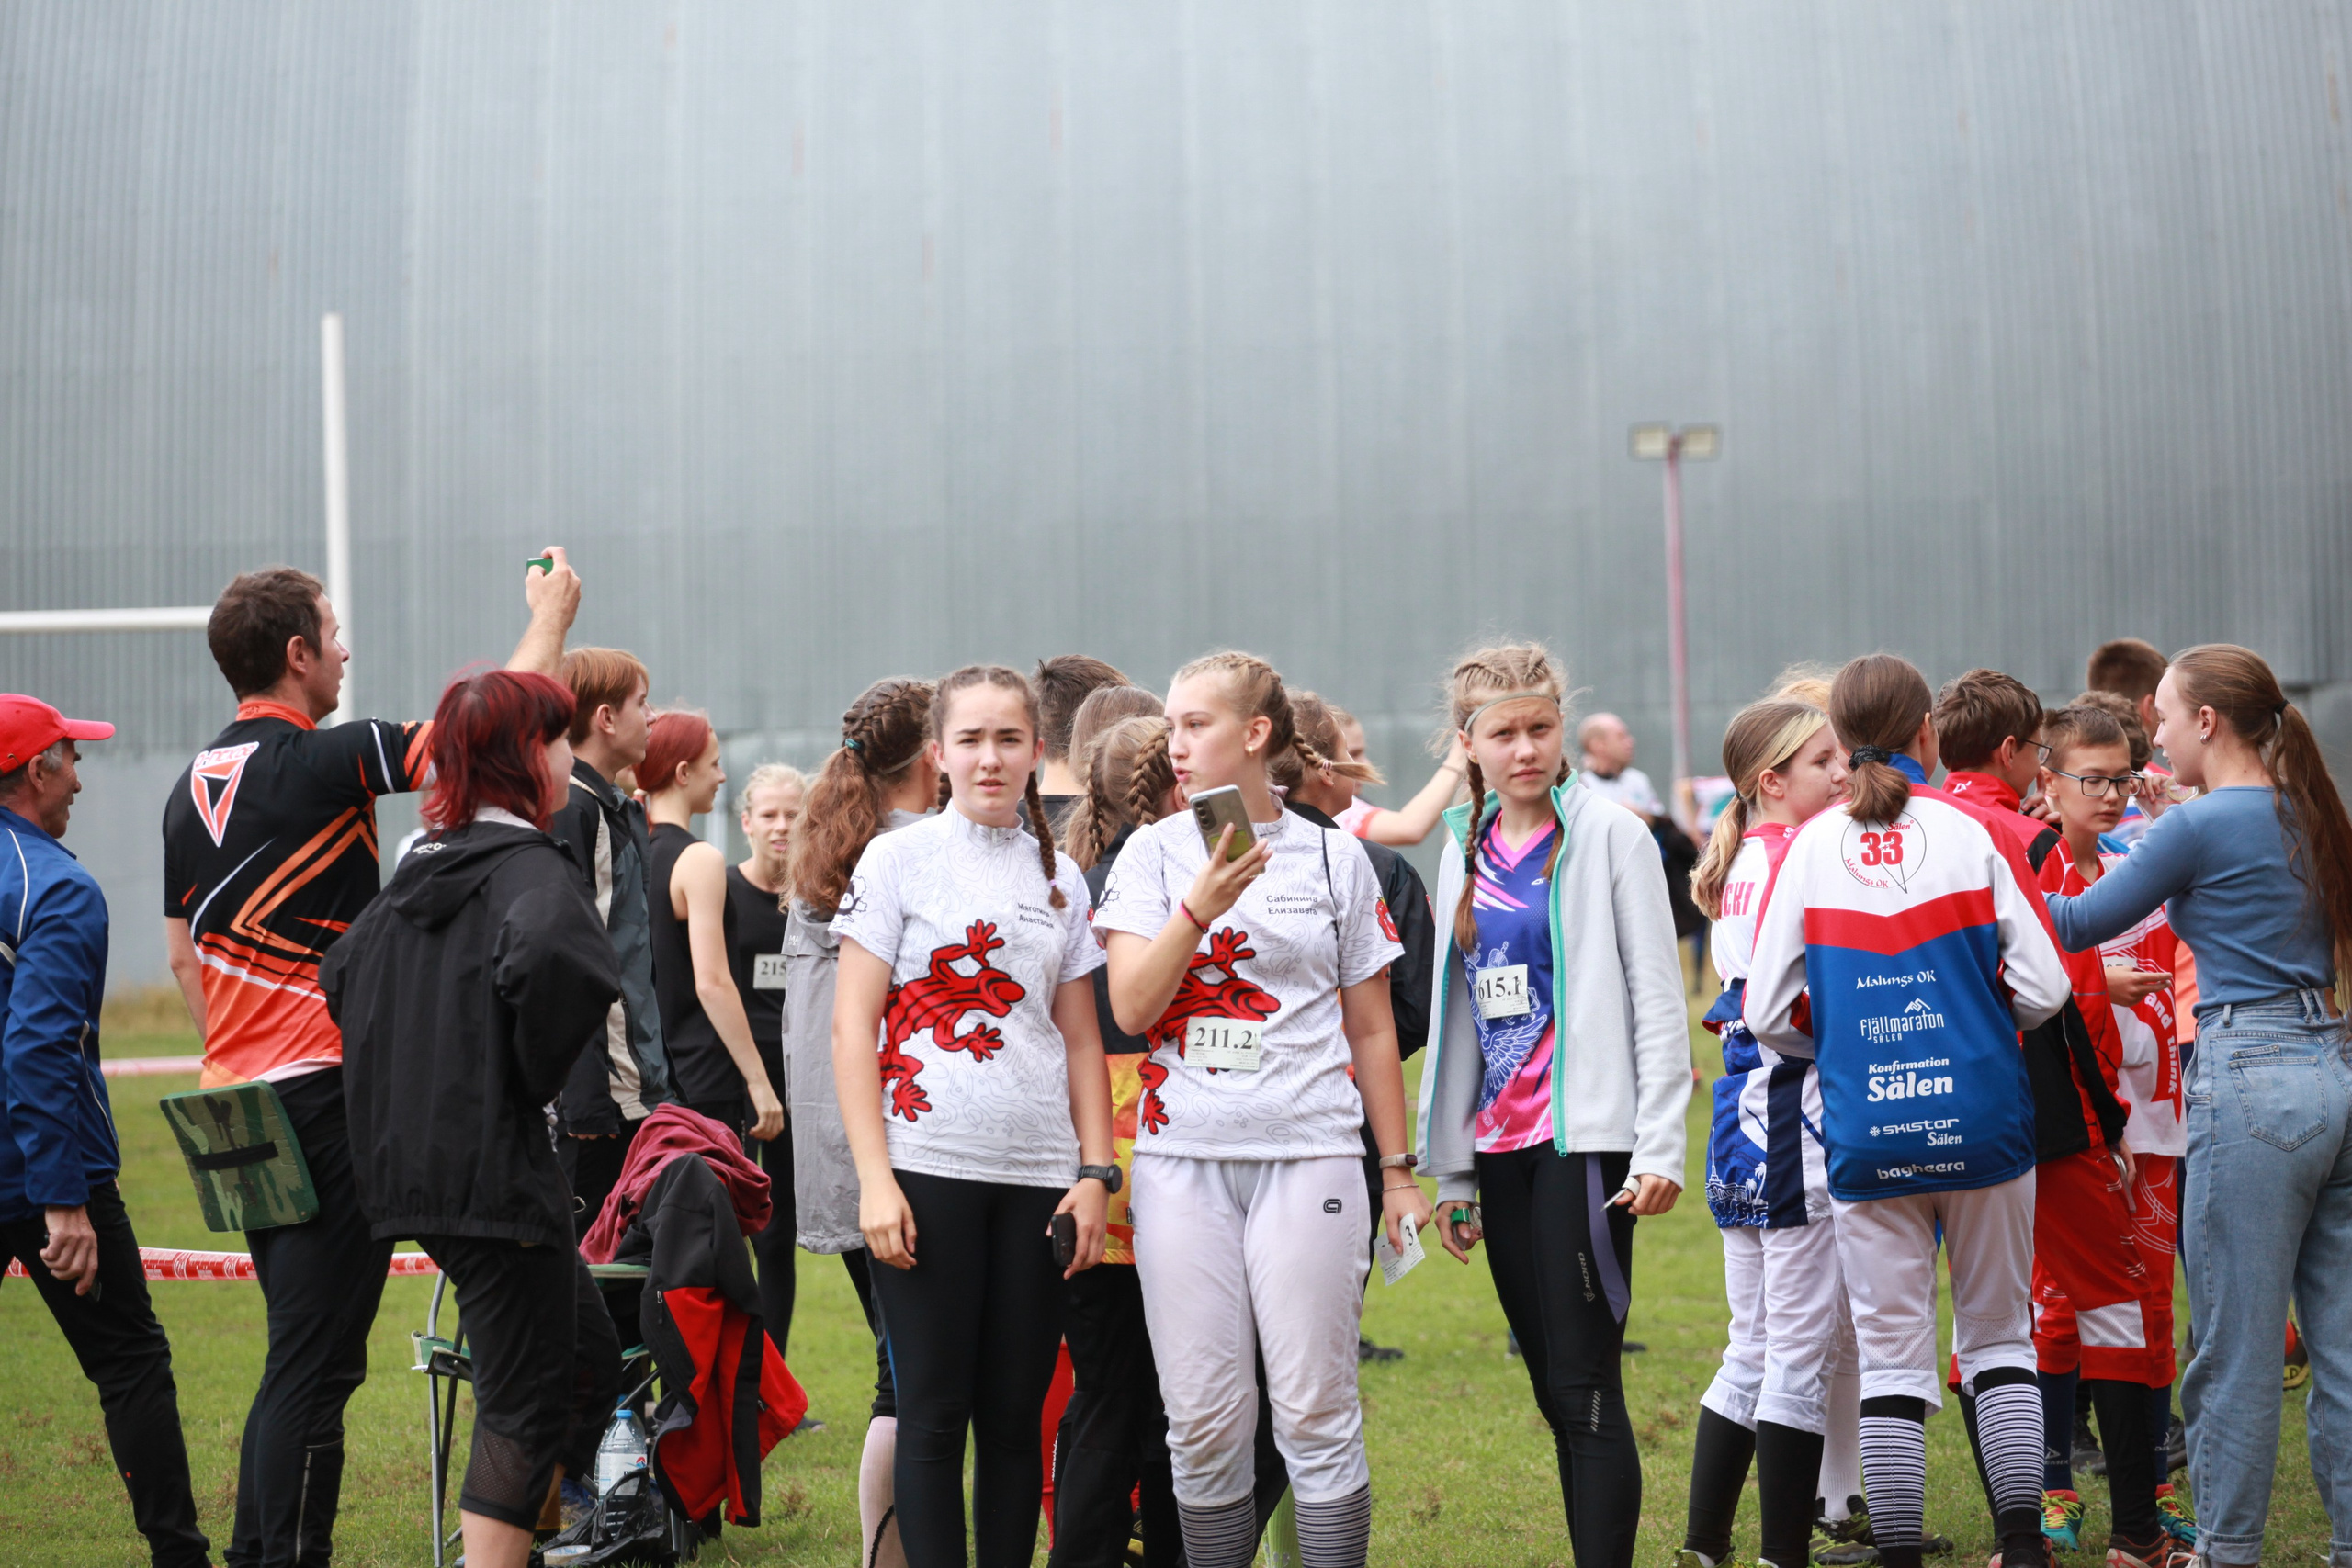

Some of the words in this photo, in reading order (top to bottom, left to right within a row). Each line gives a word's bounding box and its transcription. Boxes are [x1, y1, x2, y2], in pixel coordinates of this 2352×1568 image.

[1887, 821, 1911, 831] Sälen
[1860, 830, 1904, 866] 33
[1876, 879, 1889, 888] OK
[1266, 894, 1318, 903] Сабинина
[1267, 907, 1317, 916] Елизавета
[1019, 914, 1054, 929] Анастасия
[1478, 975, 1521, 1000] 615.1
[1856, 975, 1914, 990] Malungs
[1917, 969, 1936, 983] OK
[1193, 1026, 1253, 1050] 211.2
[2143, 992, 2173, 1030] and
[2167, 1035, 2177, 1094] think
[1868, 1056, 1950, 1075] Konfirmation
[1867, 1071, 1954, 1102] Sälen
[1927, 1131, 1962, 1146] Sälen
[1876, 1161, 1965, 1179] bagheera
